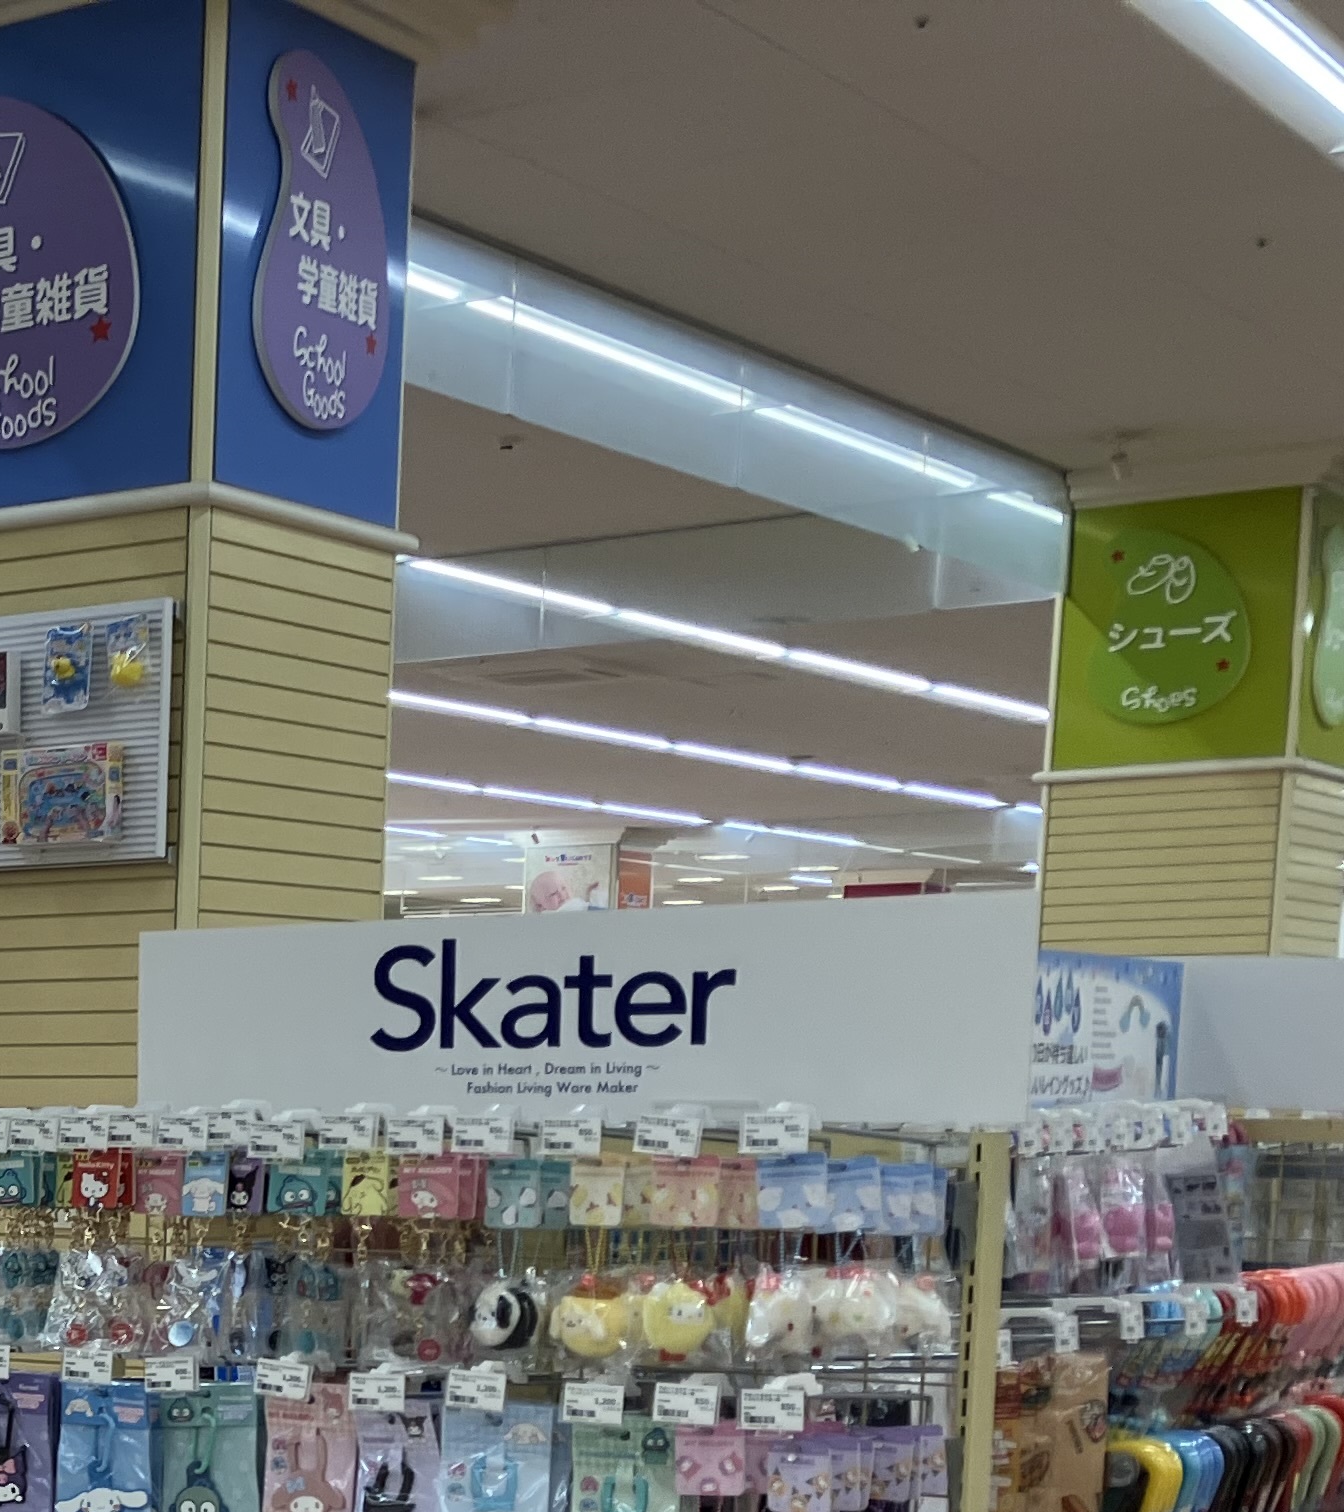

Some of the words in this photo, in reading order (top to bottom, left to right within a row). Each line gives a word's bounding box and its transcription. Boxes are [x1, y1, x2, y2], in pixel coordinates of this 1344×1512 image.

[297, 256, 379, 332] 学童雑貨
[294, 325, 346, 384] School
[302, 372, 346, 420] Goods
[1107, 610, 1237, 652] シューズ
[1120, 685, 1198, 712] Shoes
[370, 938, 737, 1052] Skater
[451, 1062, 479, 1076] Love
[482, 1062, 494, 1076] in
[497, 1062, 532, 1076] Heart
[544, 1061, 586, 1075] Dream
[590, 1061, 601, 1074] in
[606, 1061, 642, 1078] Living
[466, 1082, 513, 1095] Fashion
[517, 1081, 552, 1097] Living
[556, 1081, 592, 1094] Ware
[596, 1080, 639, 1094] Maker
